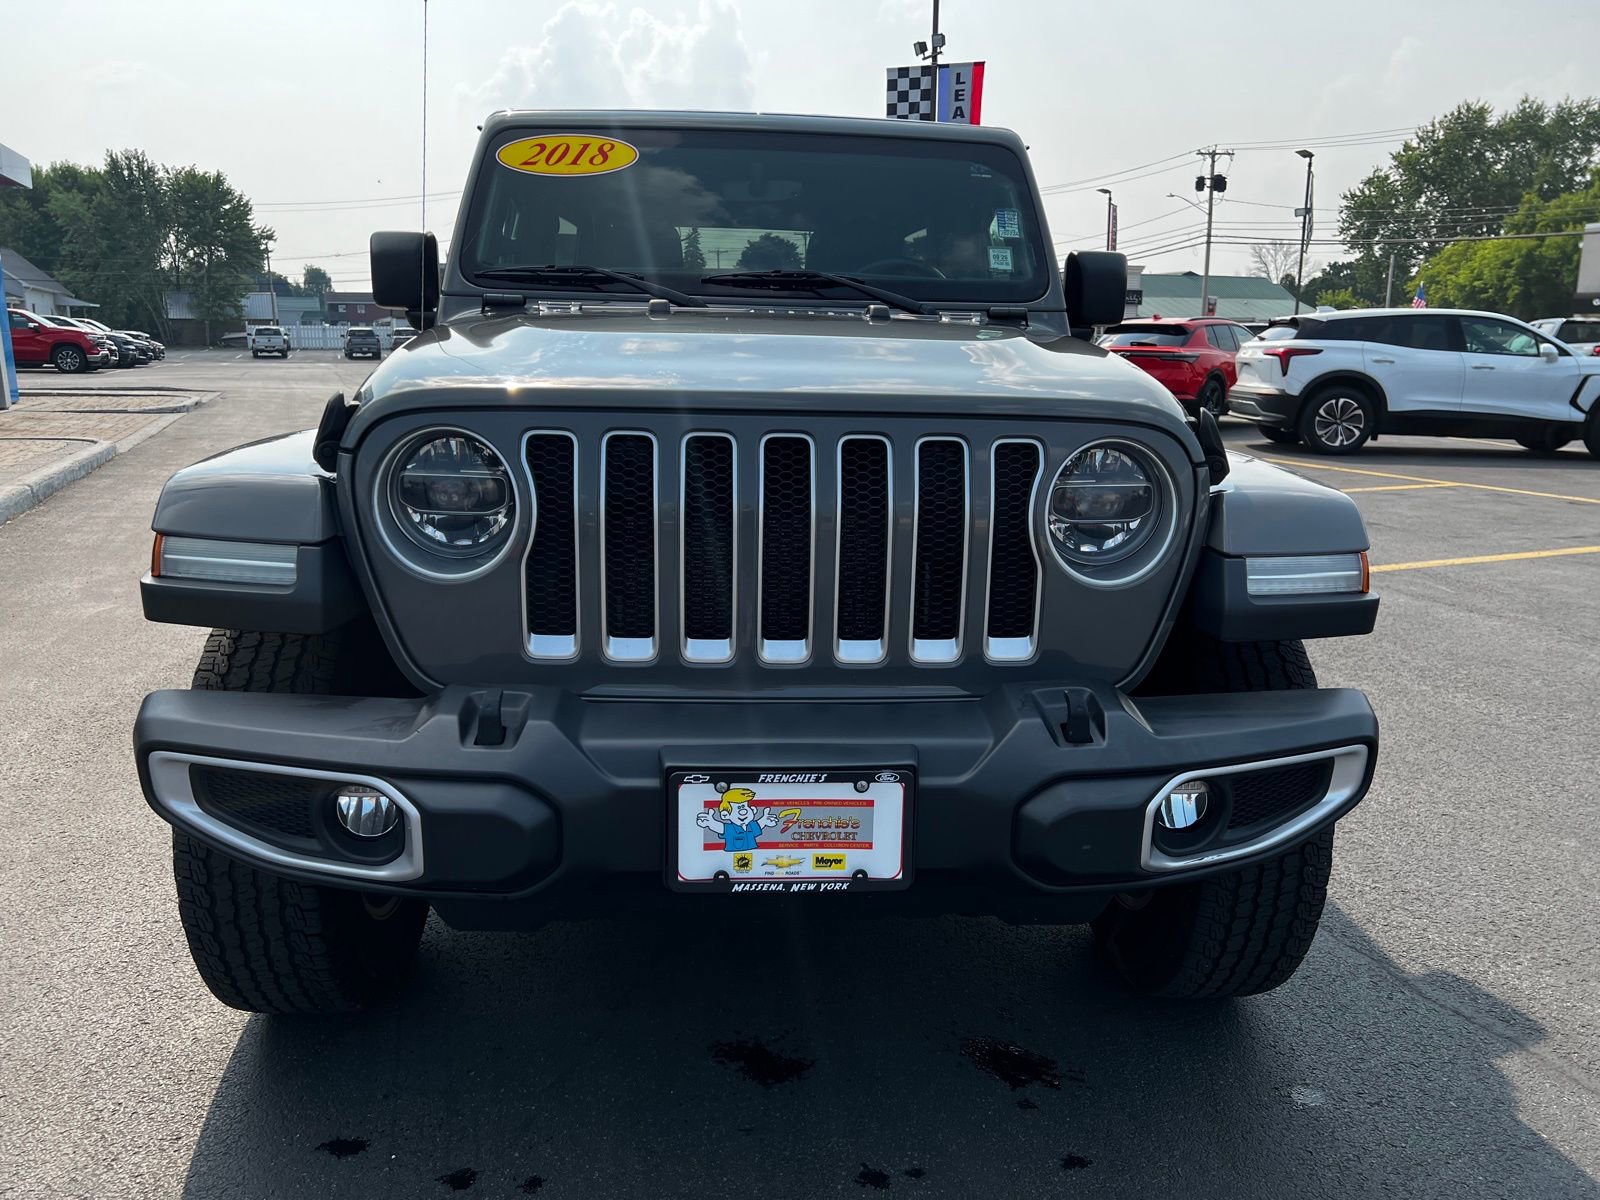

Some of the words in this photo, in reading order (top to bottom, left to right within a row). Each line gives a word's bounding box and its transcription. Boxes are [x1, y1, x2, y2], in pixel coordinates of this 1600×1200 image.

[519, 142, 616, 166] 2018
[758, 774, 827, 783] FRENCHIE'S
[879, 774, 895, 782] Ford
[778, 808, 861, 834] Frenchie's
[791, 831, 858, 840] CHEVROLET
[815, 856, 843, 868] Meyer
[790, 883, 816, 892] NEW
[820, 882, 850, 891] YORK
